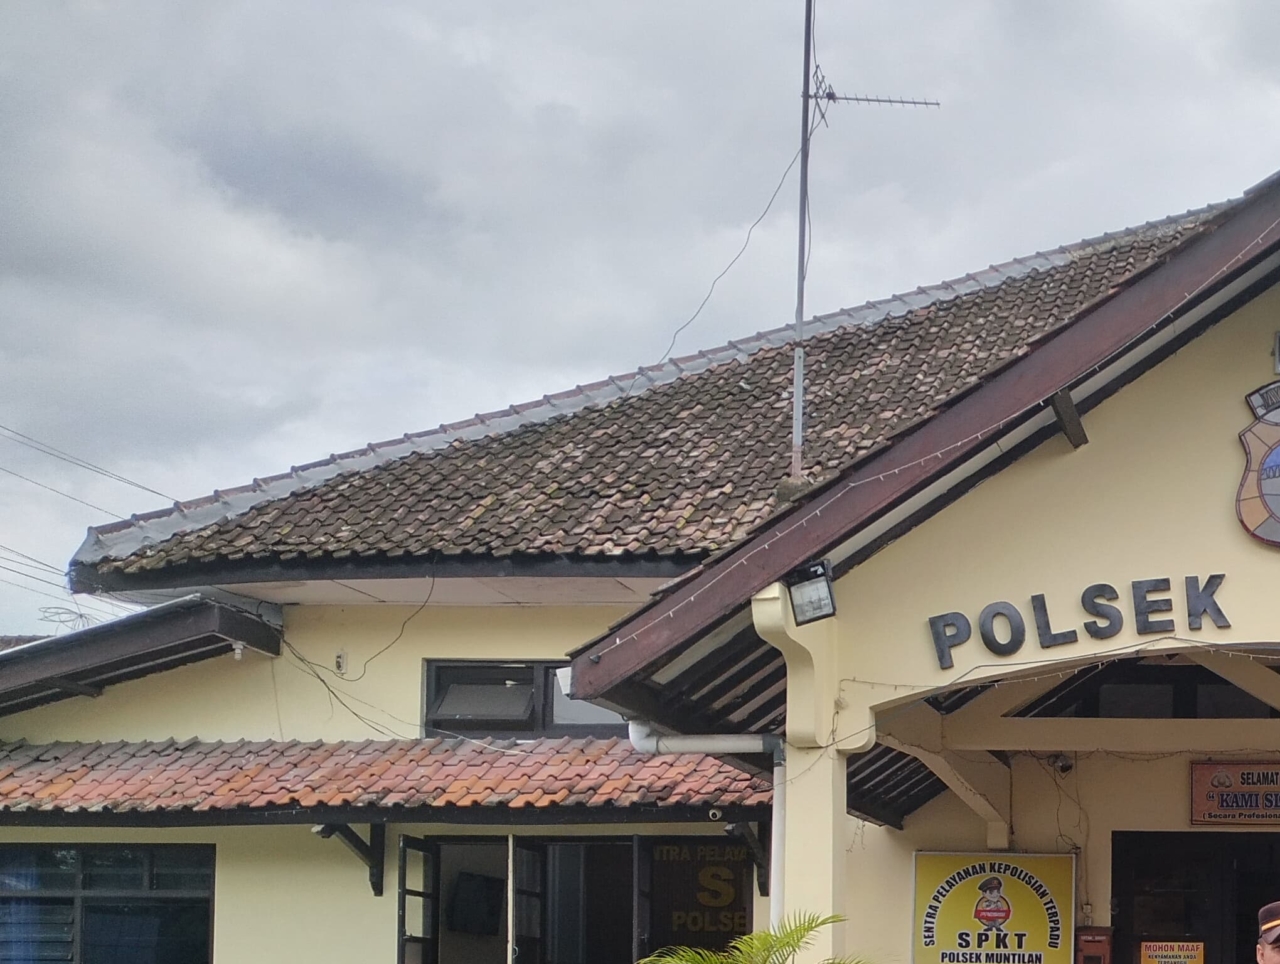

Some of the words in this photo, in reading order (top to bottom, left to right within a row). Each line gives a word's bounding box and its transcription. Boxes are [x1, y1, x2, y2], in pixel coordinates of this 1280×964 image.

[927, 573, 1231, 670] POLSEK
[1240, 771, 1279, 785] SELAMAT
[1219, 793, 1260, 808] KAMI
[924, 904, 940, 947] SENTRA
[932, 862, 987, 904] PELAYANAN
[989, 862, 1049, 900] KEPOLISIAN
[1043, 898, 1061, 949] TERPADU
[671, 911, 746, 932] POLSE
[1144, 944, 1175, 952] MOHON
[1177, 944, 1201, 952] MAAF
[941, 952, 981, 964] POLSEK
[985, 952, 1043, 964] MUNTILAN
